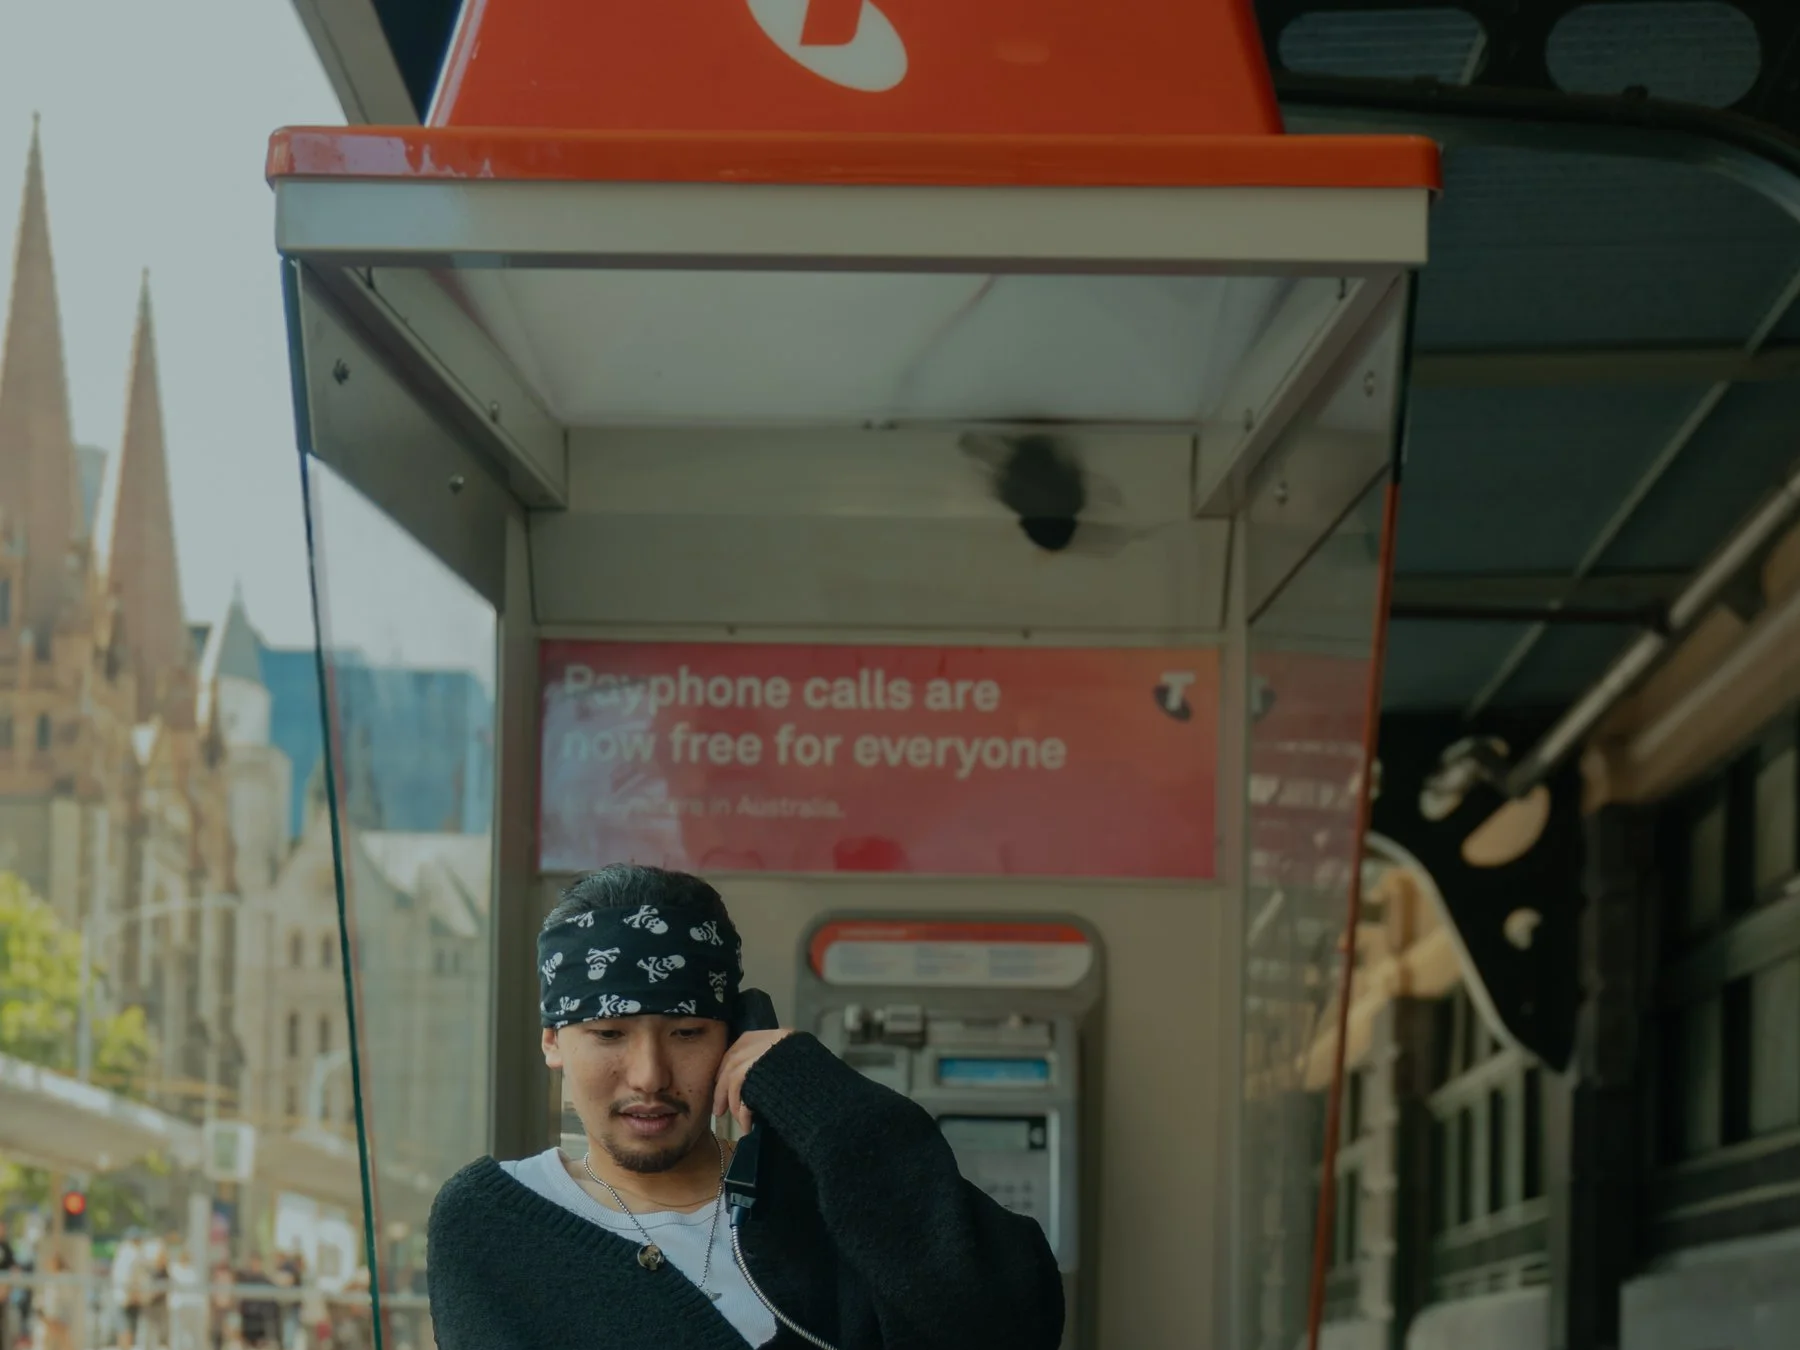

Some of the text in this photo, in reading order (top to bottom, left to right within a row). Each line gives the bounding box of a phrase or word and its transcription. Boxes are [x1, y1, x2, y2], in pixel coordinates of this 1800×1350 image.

[564, 664, 1001, 717] Payphone calls are
[561, 722, 1067, 781] now free for everyone
